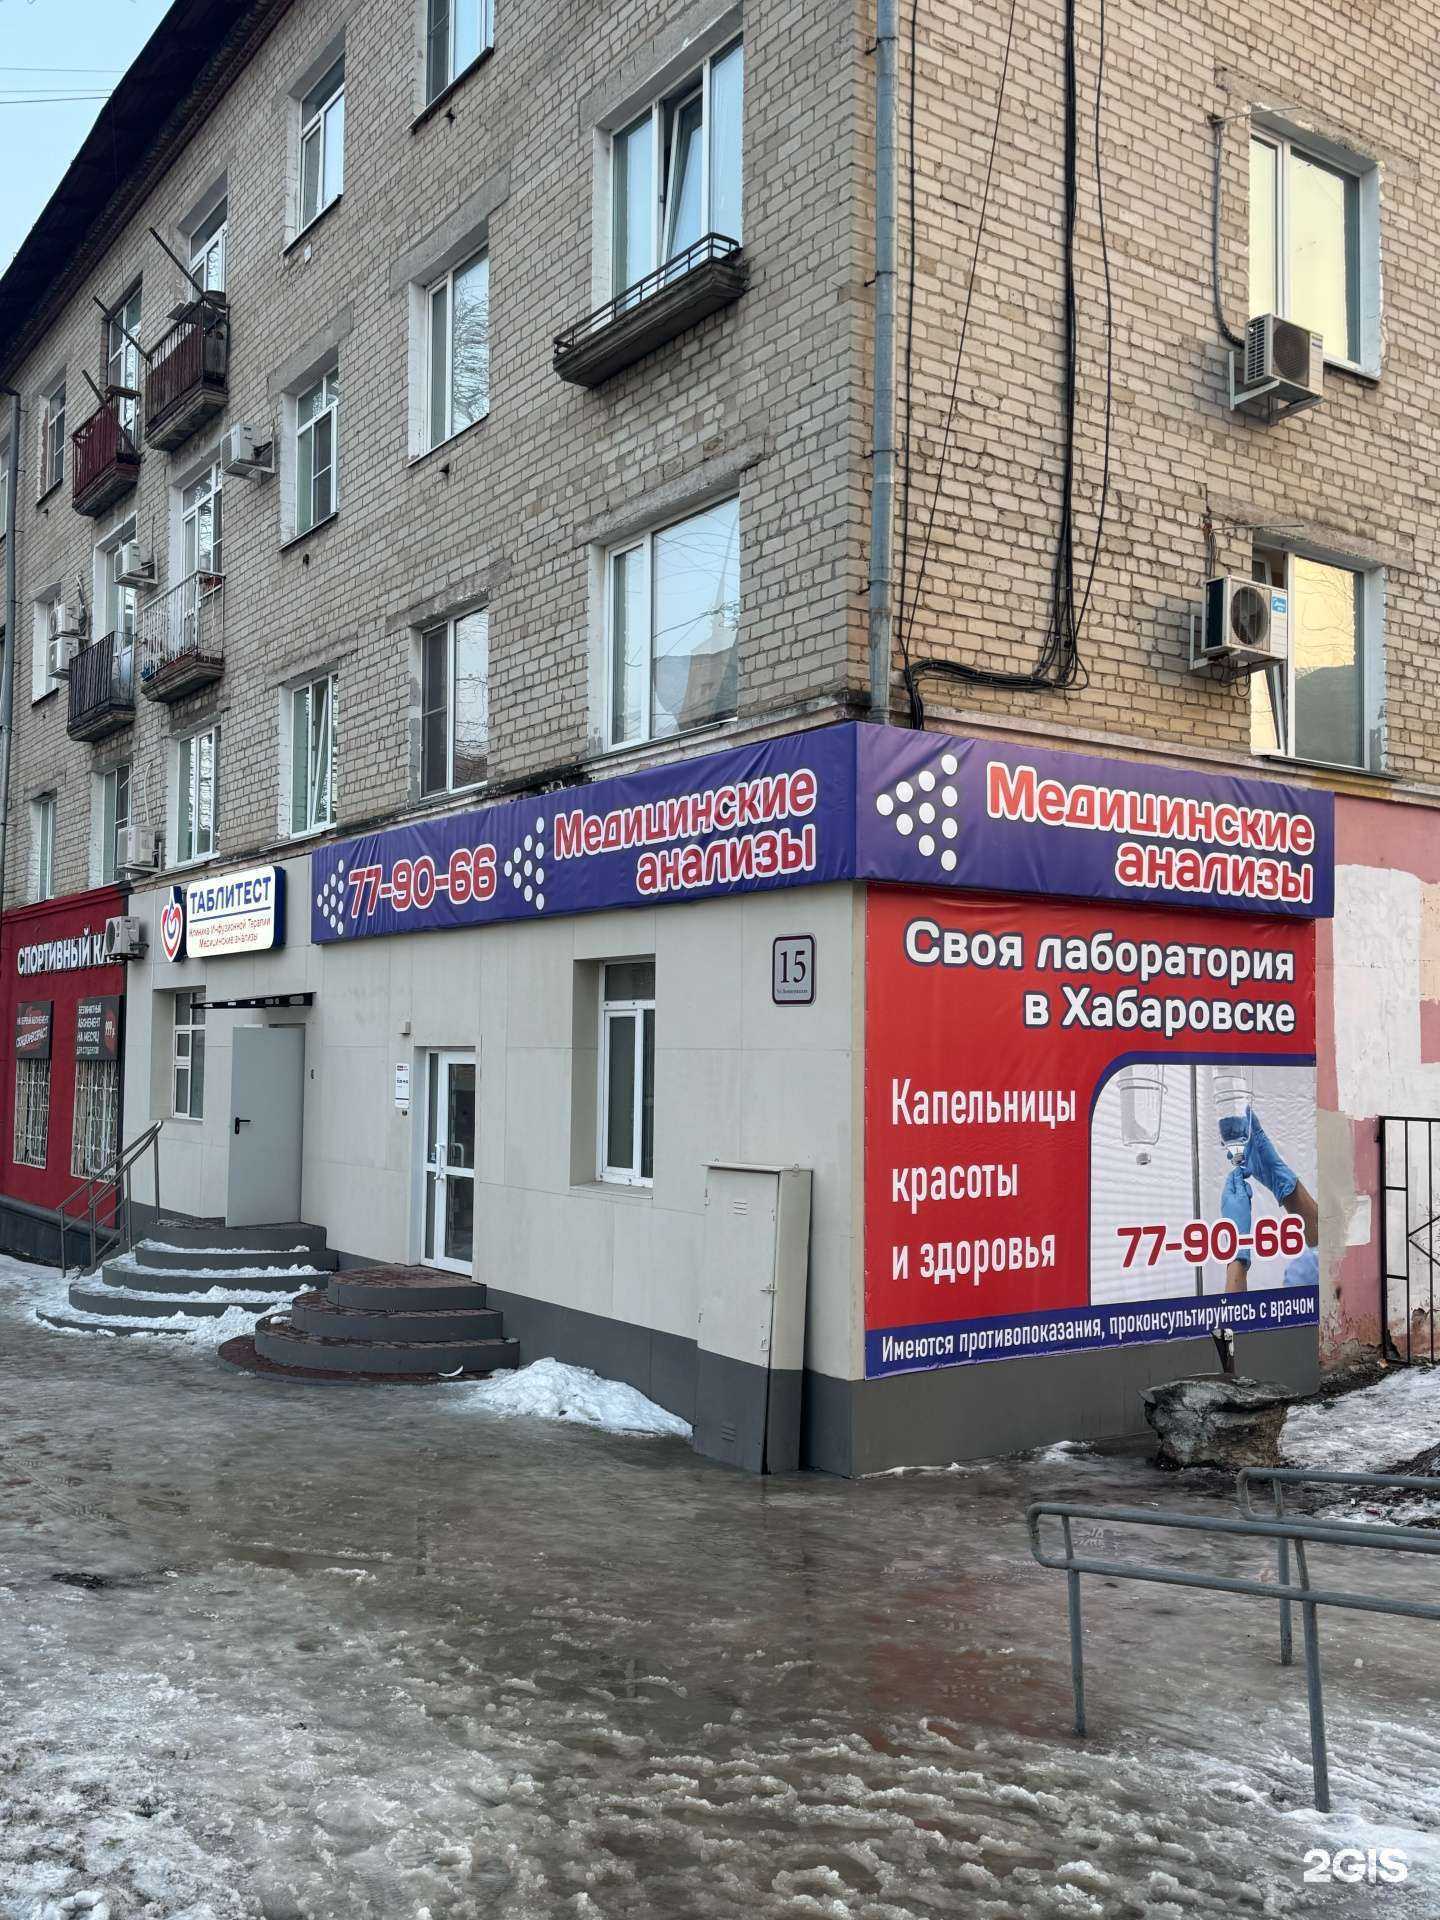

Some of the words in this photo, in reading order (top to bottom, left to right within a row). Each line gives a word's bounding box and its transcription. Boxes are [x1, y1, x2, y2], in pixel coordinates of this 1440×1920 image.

[552, 767, 818, 861] Медицинские
[985, 760, 1315, 856] Медицинские
[347, 843, 498, 919] 77-90-66
[636, 824, 817, 896] анализы
[1115, 841, 1314, 904] анализы
[190, 876, 272, 915] ТАБЛИТЕСТ
[17, 927, 91, 975] СПОРТИВНЫЙ
[780, 950, 806, 983] 15
[905, 920, 1023, 968] Своя
[1037, 932, 1295, 987] лаборатория
[1025, 994, 1048, 1026] в
[1062, 986, 1296, 1037] Хабаровске
[891, 1078, 1077, 1130] Капельницы
[891, 1163, 1018, 1214] красоты
[891, 1245, 908, 1281] и
[919, 1234, 1056, 1286] здоровья
[1116, 1214, 1306, 1271] 77-90-66
[881, 1333, 954, 1363] Имеются
[958, 1317, 1106, 1360] противопоказания,
[1109, 1298, 1257, 1336] проконсультируйтесь
[1259, 1302, 1268, 1320] с
[1269, 1295, 1315, 1324] врачом
